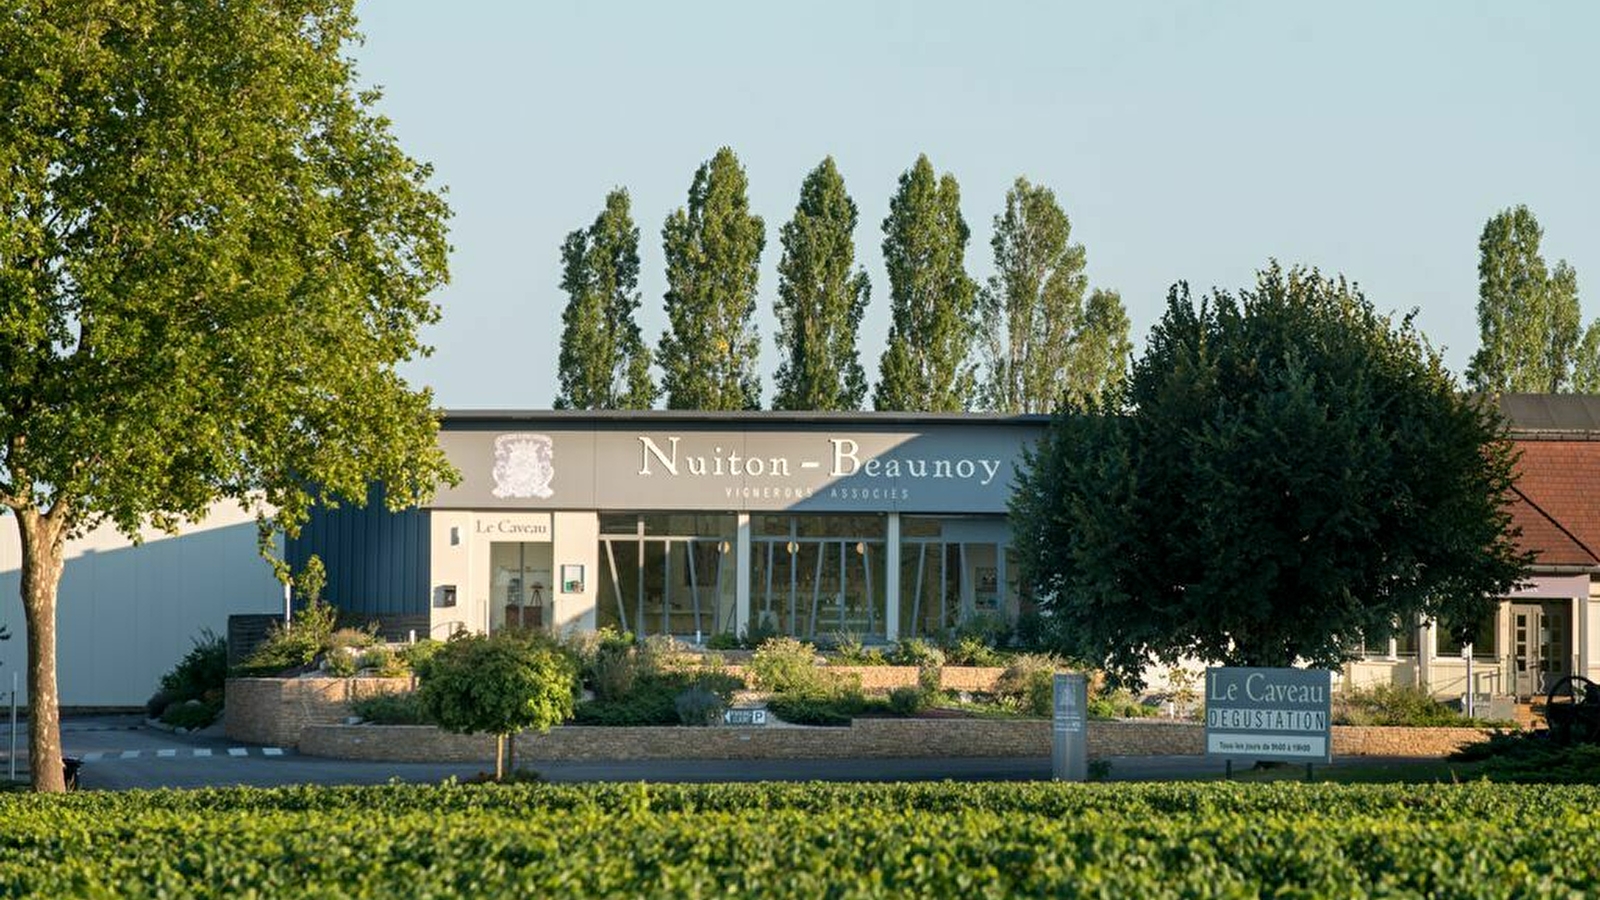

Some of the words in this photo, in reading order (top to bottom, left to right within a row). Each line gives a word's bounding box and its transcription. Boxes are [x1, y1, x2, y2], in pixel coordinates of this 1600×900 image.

[725, 487, 813, 499] VIGNERONS
[476, 519, 495, 533] Le
[498, 519, 547, 534] Caveau
[1211, 672, 1239, 701] Le
[1245, 672, 1324, 703] Caveau
[1209, 709, 1325, 730] DEGUSTATION
